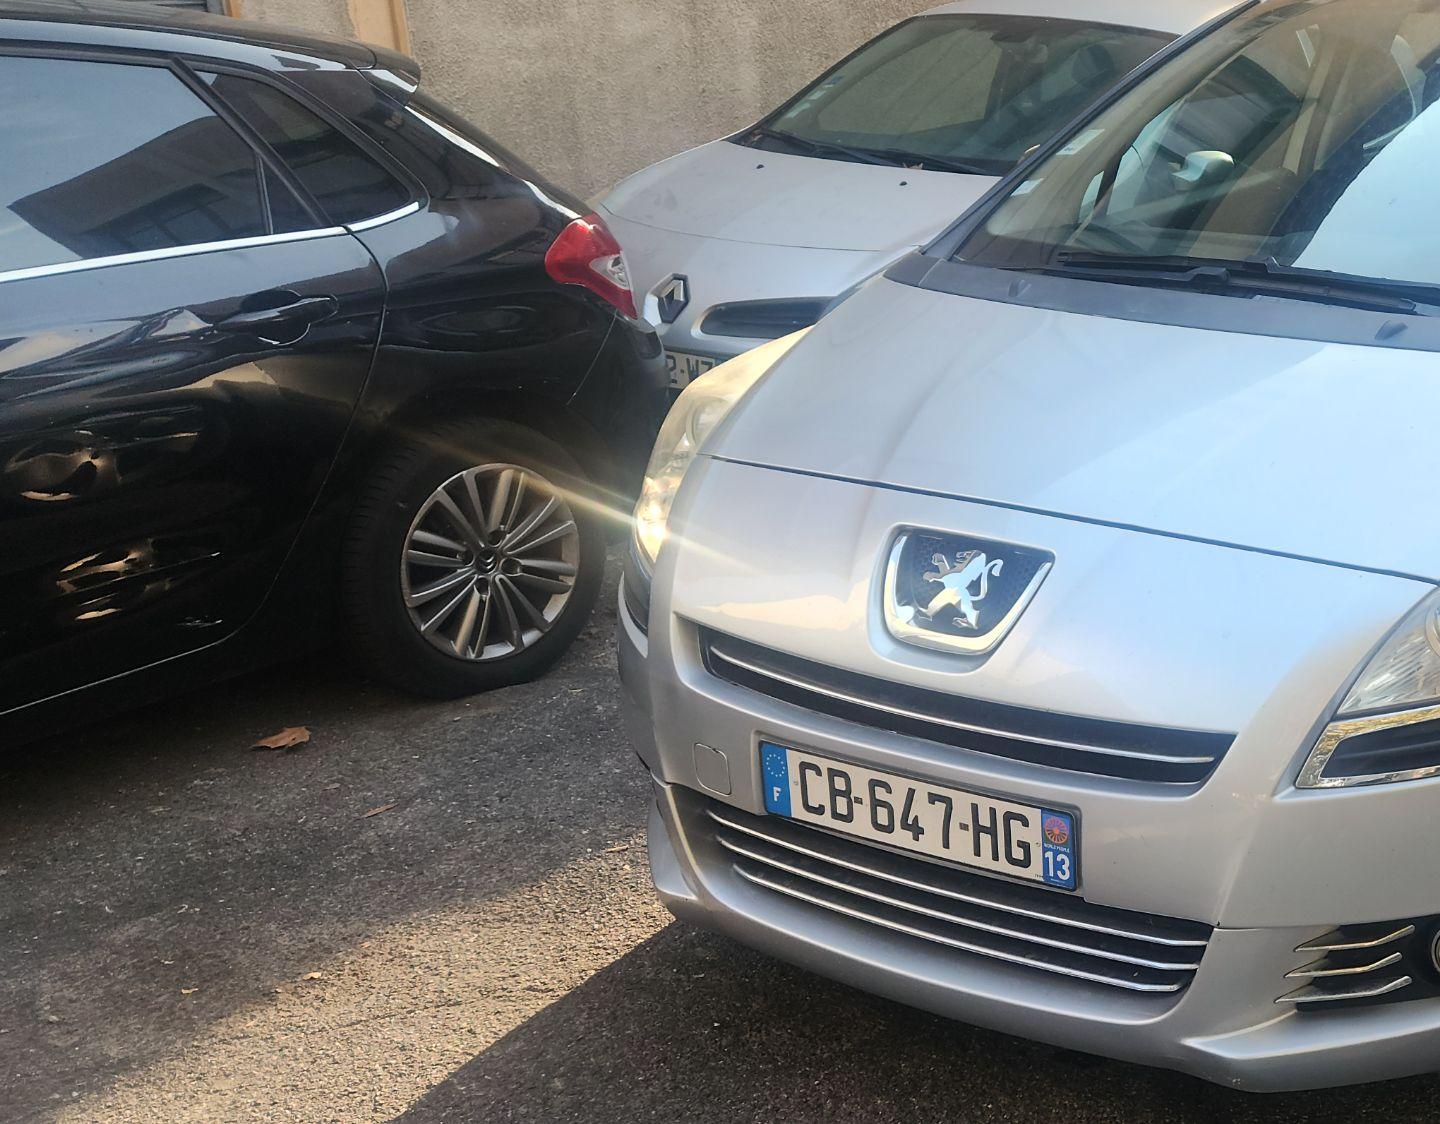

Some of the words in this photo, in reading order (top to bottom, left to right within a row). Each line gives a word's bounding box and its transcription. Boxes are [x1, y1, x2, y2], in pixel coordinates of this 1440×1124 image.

[773, 786, 782, 802] F
[799, 761, 1031, 869] CB-647-HG
[1044, 851, 1070, 881] 13
